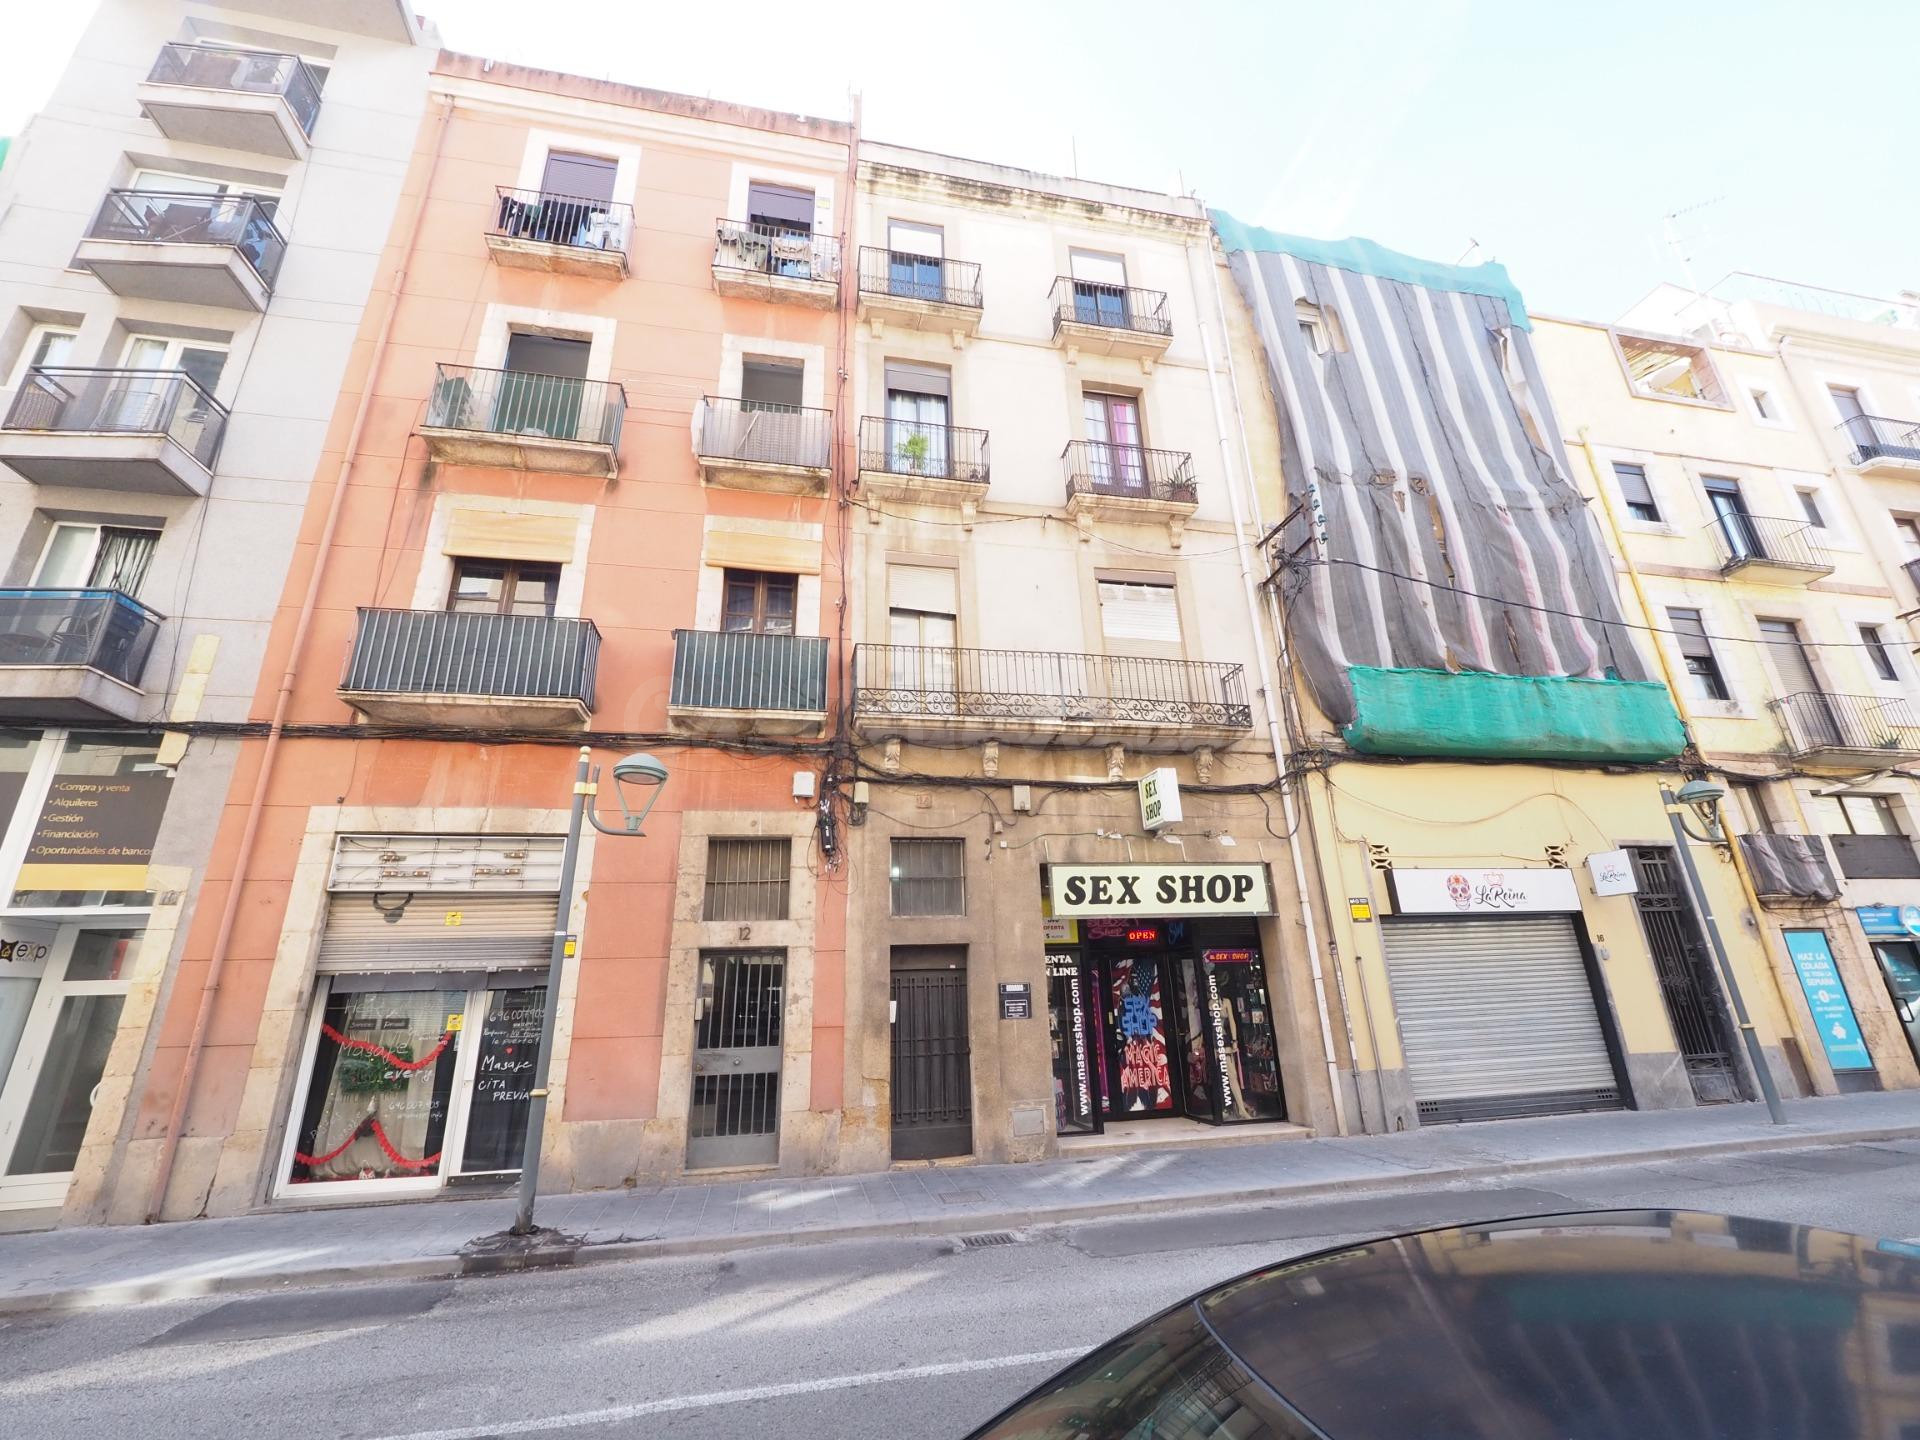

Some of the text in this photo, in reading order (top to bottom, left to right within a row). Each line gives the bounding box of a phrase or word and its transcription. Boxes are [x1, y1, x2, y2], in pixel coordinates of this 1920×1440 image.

[60, 782, 97, 793] Compra
[97, 785, 103, 793] y
[52, 798, 99, 808] Alquileres
[1146, 800, 1161, 821] SHOP
[47, 813, 84, 823] Gestión
[42, 829, 99, 839] Financiación
[36, 845, 106, 857] Oportunidades
[107, 847, 120, 855] de
[1064, 874, 1254, 905] SEX SHOP
[1490, 886, 1527, 908] Reina
[739, 926, 751, 940] 12
[1129, 931, 1155, 940] OPEN
[1053, 967, 1078, 976] LINE
[1071, 979, 1089, 1115] www.masexshop.com
[1209, 975, 1232, 1106] www.masexshop.com
[481, 1055, 533, 1072] Masaje
